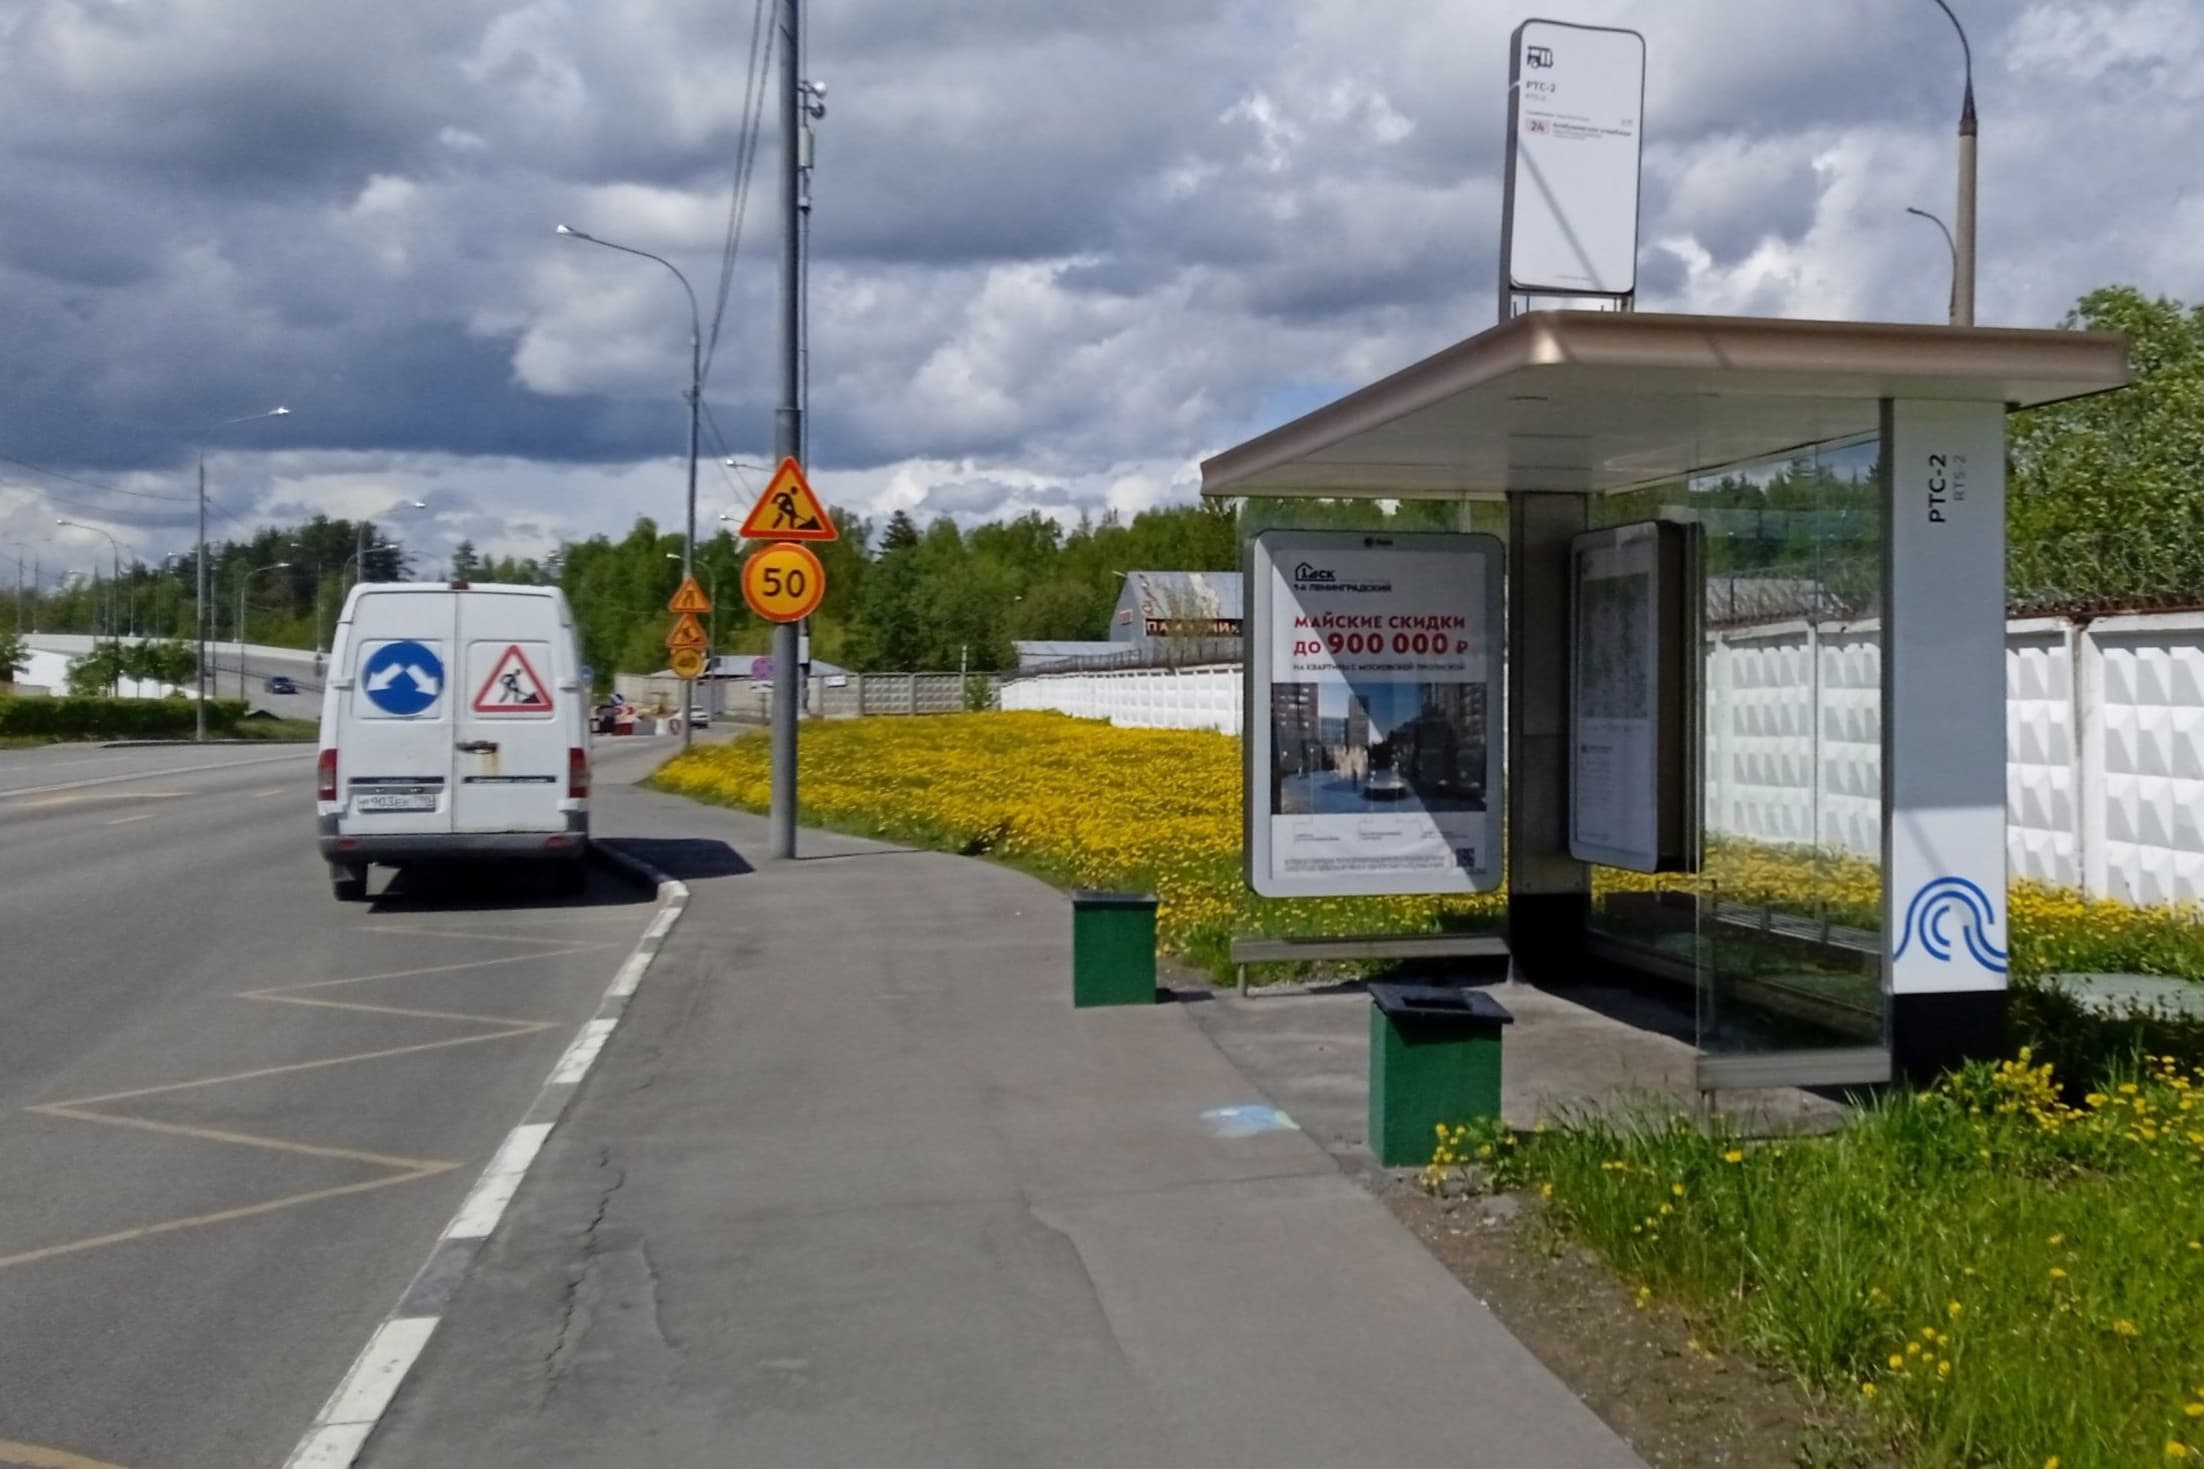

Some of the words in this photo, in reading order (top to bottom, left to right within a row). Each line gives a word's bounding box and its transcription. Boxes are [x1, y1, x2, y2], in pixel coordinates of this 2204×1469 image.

[1526, 80, 1556, 93] РТС-2
[1929, 453, 1947, 523] РТС-2
[1953, 454, 1968, 501] RTS-2
[763, 567, 805, 598] 50
[1294, 611, 1383, 629] МАЙСКИЕ
[1388, 615, 1466, 632] СКИДКИ
[1293, 641, 1321, 656] ДО
[1327, 632, 1384, 655] 900
[1392, 632, 1449, 655] 000
